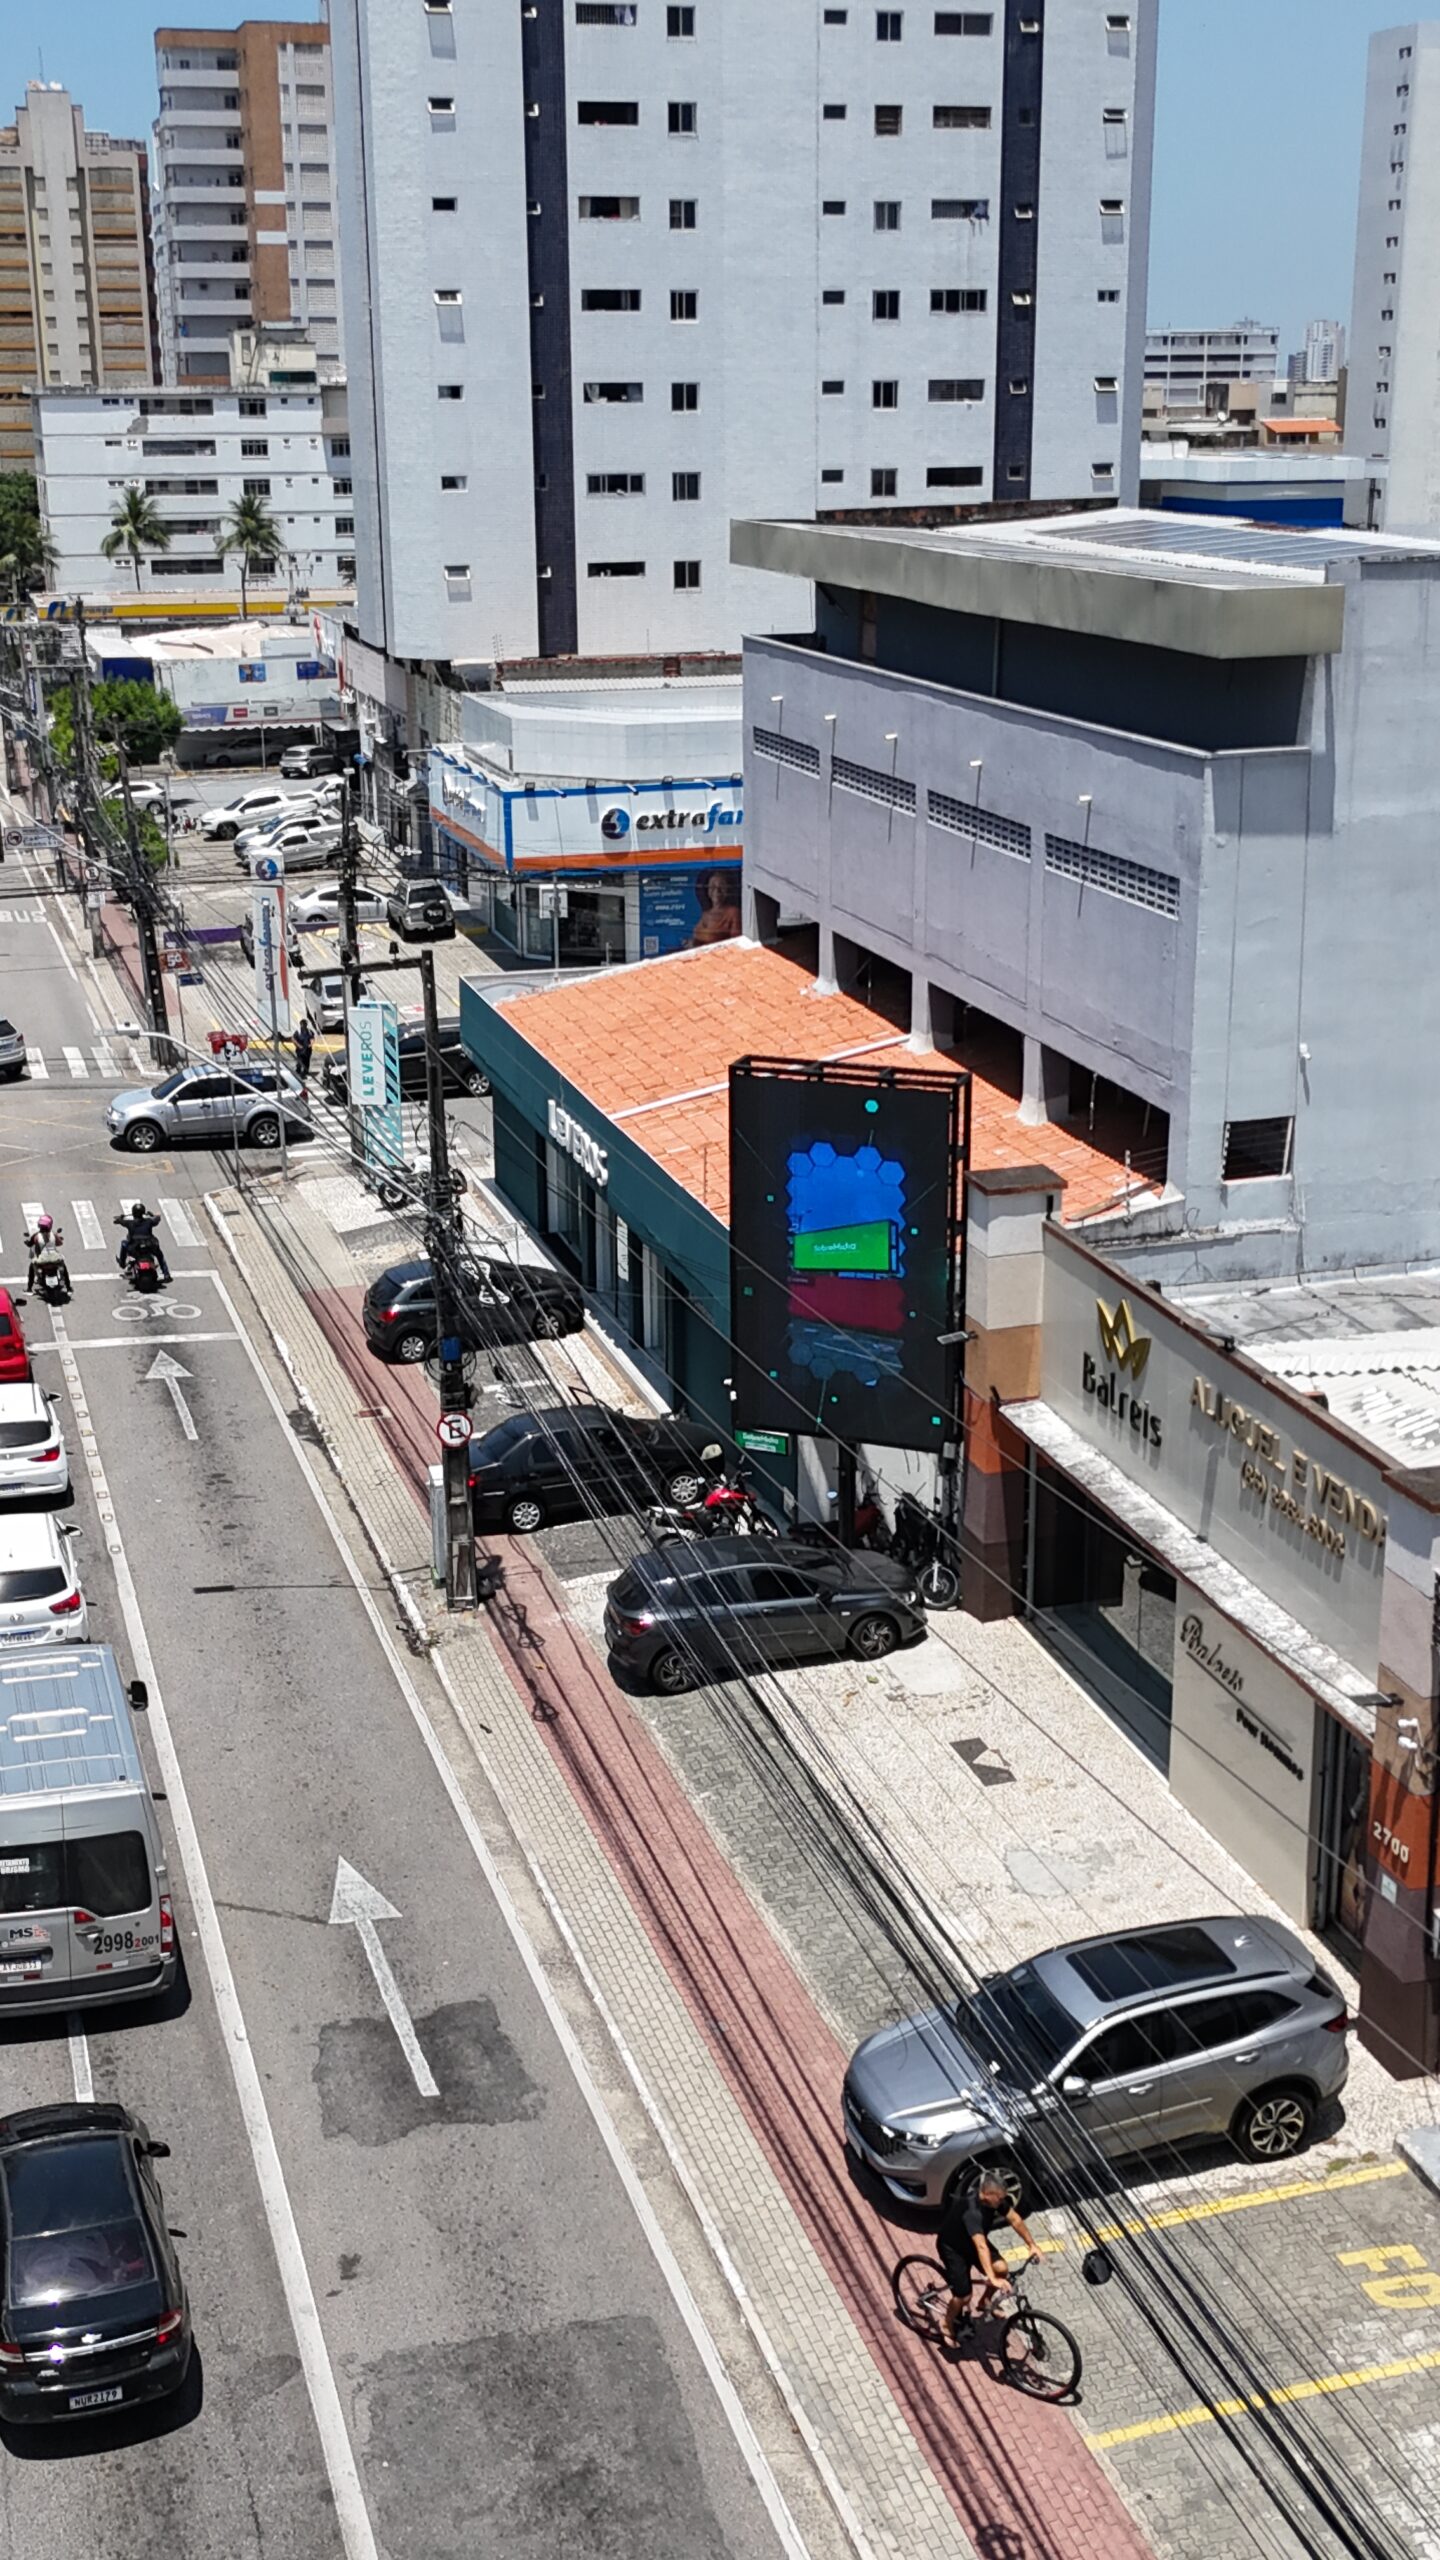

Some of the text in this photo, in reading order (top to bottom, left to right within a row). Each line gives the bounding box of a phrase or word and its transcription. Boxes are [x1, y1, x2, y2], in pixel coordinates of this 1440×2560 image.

[359, 1020, 375, 1097] LEVEROS
[547, 1099, 608, 1187] LEVEROS
[448, 1419, 463, 1439] E
[1082, 1351, 1162, 1448] Balreis
[1189, 1375, 1287, 1472] ALUGUEL
[1292, 1450, 1309, 1487] E
[1372, 1820, 1410, 1865] 2700
[92, 1930, 134, 1955] 2998
